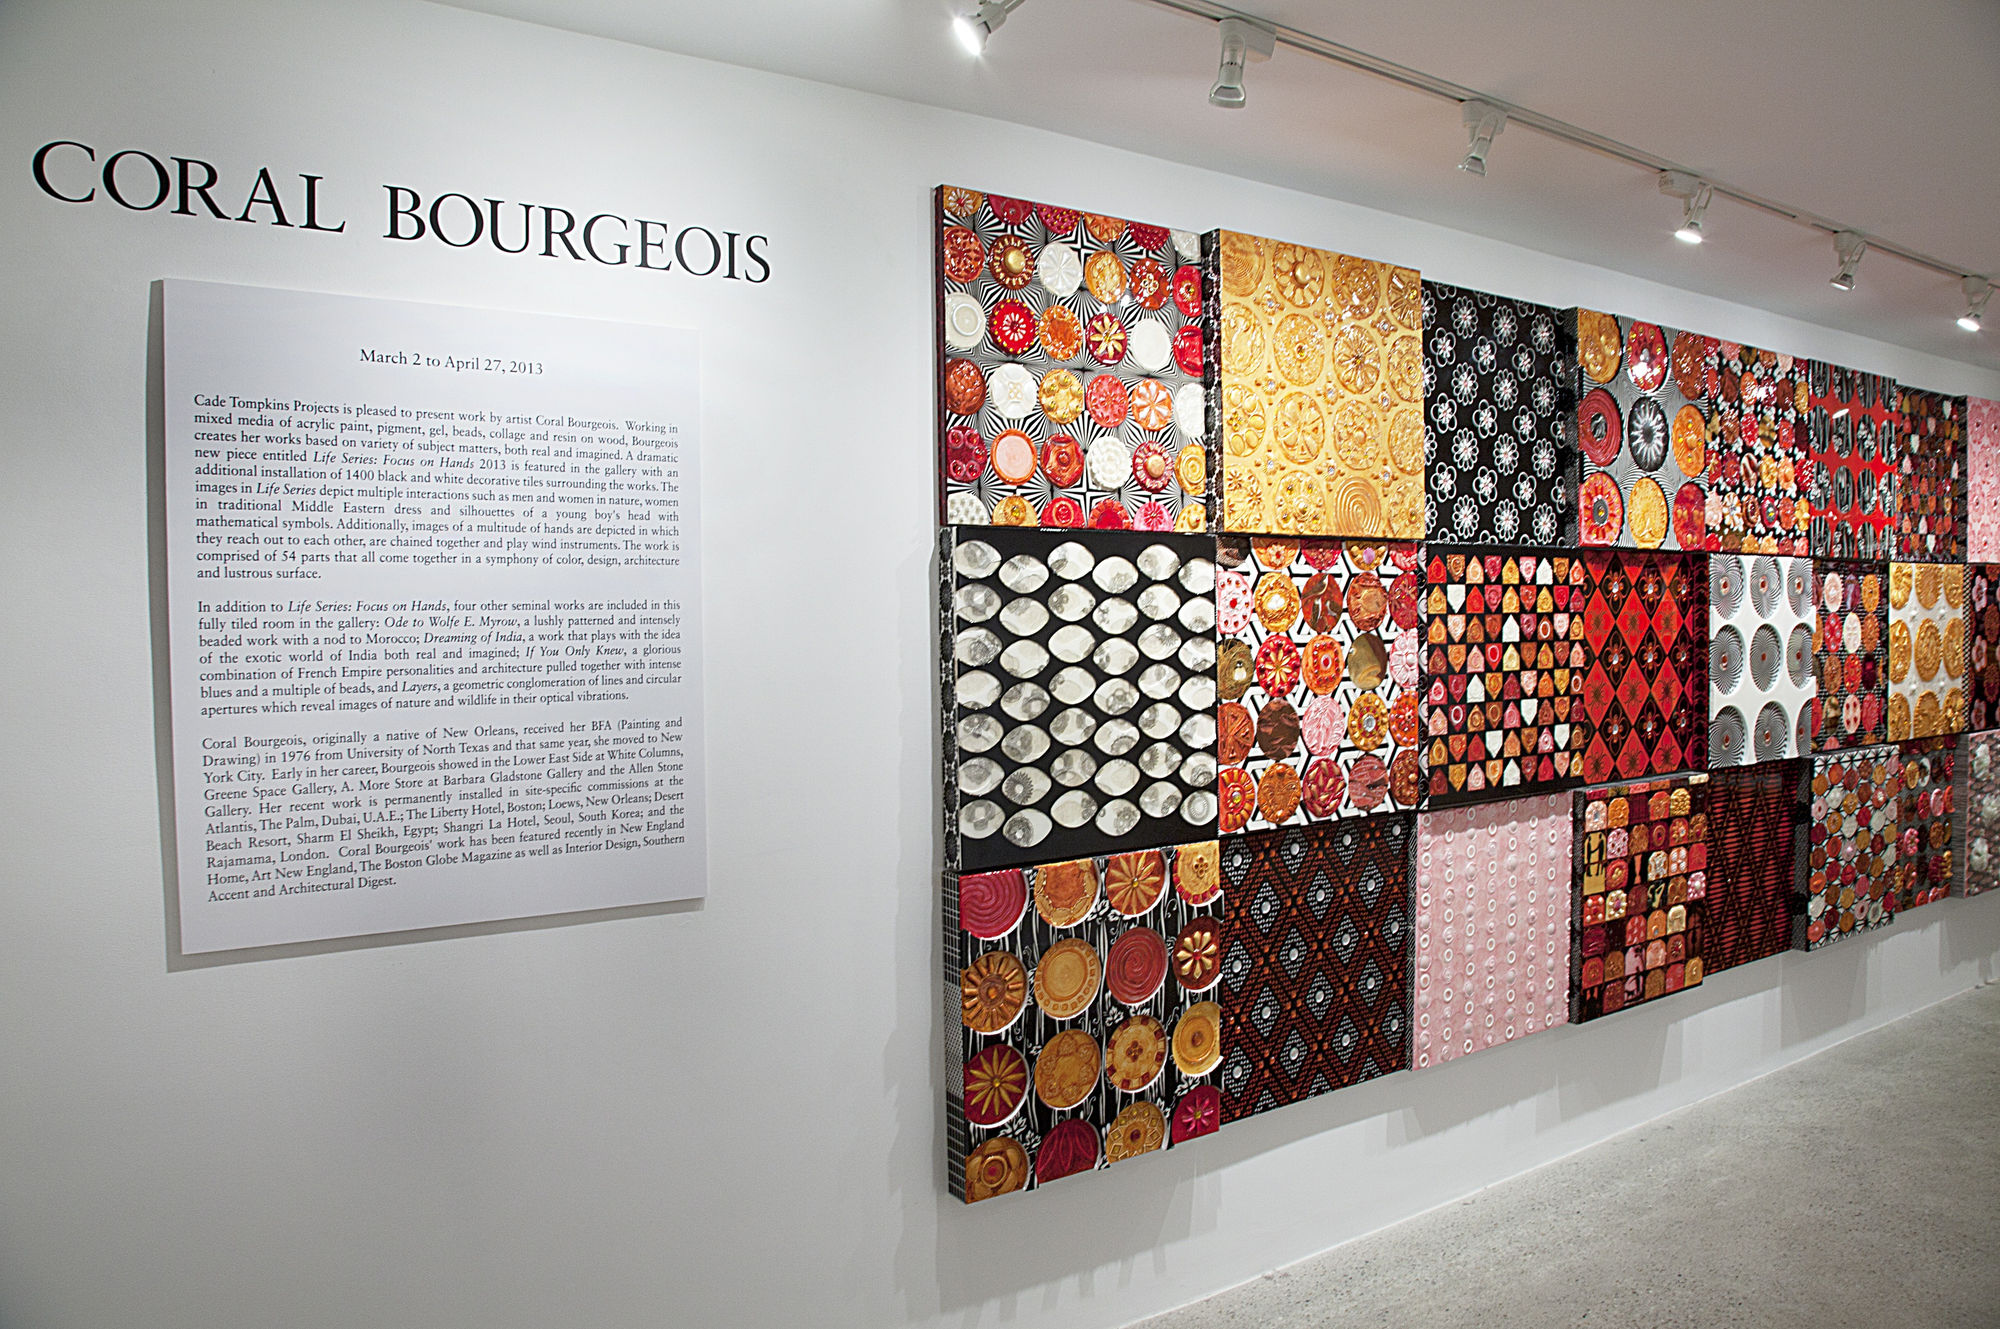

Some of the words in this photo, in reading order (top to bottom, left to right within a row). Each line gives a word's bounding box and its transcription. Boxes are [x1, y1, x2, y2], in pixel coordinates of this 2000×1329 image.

[32, 140, 346, 233] CORAL
[382, 184, 770, 283] BOURGEOIS
[359, 349, 407, 364] March
[412, 353, 421, 366] 2
[426, 357, 440, 367] to
[444, 355, 479, 372] April
[484, 358, 506, 374] 27,
[509, 360, 543, 375] 2013
[193, 393, 226, 407] Cade
[229, 395, 290, 412] Tompkins
[293, 400, 339, 415] Projects
[343, 403, 352, 414] is
[356, 403, 396, 418] pleased
[400, 409, 412, 418] to
[415, 410, 454, 421] present
[458, 410, 485, 422] work
[489, 411, 502, 426] by
[505, 414, 532, 425] artist
[535, 414, 564, 427] Coral
[567, 416, 619, 431] Bourgeois.
[625, 420, 666, 435] Working
[669, 423, 678, 433] in
[194, 411, 232, 425] mixed
[237, 414, 274, 427] media
[279, 415, 292, 427] of
[296, 417, 335, 432] acrylic
[340, 420, 373, 434] paint,
[377, 421, 425, 436] pigment,
[429, 424, 448, 438] gel,
[452, 424, 486, 439] beads,
[489, 427, 526, 442] collage
[529, 430, 549, 441] and
[553, 432, 576, 443] resin
[598, 434, 628, 447] wood,
[632, 435, 679, 450] Bourgeois
[194, 462, 257, 477] additional
[260, 465, 327, 479] installation
[330, 467, 343, 480] of
[346, 469, 374, 481] 1400
[377, 469, 407, 482] black
[410, 471, 431, 483] and
[434, 472, 464, 484] white
[466, 473, 520, 486] decorative
[522, 475, 544, 487] tiles
[546, 477, 607, 492] surrounding
[609, 479, 624, 490] the
[626, 480, 659, 491] works.
[660, 481, 679, 492] The
[195, 497, 208, 509] in
[217, 498, 281, 511] traditional
[291, 500, 334, 512] Middle
[343, 501, 385, 514] Eastern
[393, 502, 422, 515] dress
[430, 504, 451, 516] and
[459, 504, 515, 517] silhouettes
[522, 506, 534, 518] of
[541, 510, 547, 518] a
[556, 511, 587, 522] young
[594, 508, 620, 522] boy's
[627, 509, 650, 521] head
[658, 510, 679, 521] with
[196, 549, 259, 564] comprised
[264, 549, 278, 561] of
[281, 550, 296, 562] 54
[301, 553, 330, 565] parts
[334, 550, 357, 562] that
[361, 550, 375, 563] all
[379, 554, 409, 563] come
[412, 551, 458, 566] together
[461, 552, 471, 563] in
[475, 556, 481, 564] a
[485, 552, 539, 567] symphony
[542, 552, 553, 564] of
[556, 553, 584, 566] color,
[587, 553, 621, 568] design,
[623, 554, 680, 566] architecture
[197, 565, 220, 578] and
[224, 566, 273, 578] lustrous
[276, 566, 321, 579] surface.
[198, 617, 226, 632] fully
[231, 617, 258, 629] tiled
[262, 620, 295, 629] room
[299, 617, 311, 629] in
[315, 616, 334, 629] the
[337, 616, 379, 631] gallery:
[384, 615, 409, 628] Ode
[412, 618, 424, 627] to
[428, 615, 460, 629] Wolfe
[463, 616, 475, 627] E.
[478, 615, 520, 629] Myrow,
[523, 618, 530, 626] a
[534, 614, 564, 629] lushly
[567, 614, 614, 628] patterned
[617, 614, 636, 625] and
[639, 613, 680, 627] intensely
[199, 668, 276, 681] combination
[280, 666, 294, 679] of
[297, 666, 337, 679] French
[341, 665, 382, 680] Empire
[386, 663, 454, 679] personalities
[457, 662, 478, 674] and
[481, 662, 543, 674] architecture
[546, 660, 577, 675] pulled
[580, 659, 621, 674] together
[624, 658, 645, 670] with
[648, 659, 682, 669] intense
[201, 736, 237, 750] Coral
[244, 734, 307, 749] Bourgeois,
[312, 730, 367, 747] originally
[373, 733, 380, 742] a
[386, 729, 420, 741] native
[425, 727, 437, 739] of
[442, 727, 468, 738] New
[474, 724, 518, 737] Orleans,
[523, 721, 564, 734] received
[569, 721, 586, 732] her
[591, 720, 612, 731] BFA
[617, 718, 660, 731] (Painting
[664, 716, 682, 728] and
[204, 804, 252, 818] Gallery.
[259, 802, 282, 814] Her
[289, 801, 325, 812] recent
[331, 795, 362, 809] work
[368, 795, 378, 807] is
[384, 790, 452, 809] permanently
[458, 786, 503, 800] installed
[509, 786, 519, 797] in
[525, 781, 582, 797] site-specific
[587, 779, 649, 792] commissions
[654, 779, 663, 787] at
[669, 775, 684, 786] the
[206, 837, 242, 852] Beach
[248, 836, 291, 848] Resort,
[296, 832, 334, 845] Sharm
[339, 828, 352, 841] El
[357, 826, 398, 840] Sheikh,
[403, 825, 438, 839] Egypt;
[443, 819, 484, 834] Shangri
[489, 818, 502, 830] La
[507, 814, 540, 828] Hotel,
[543, 812, 574, 825] Seoul,
[578, 809, 607, 822] South
[611, 808, 644, 820] Korea;
[647, 805, 665, 817] and
[669, 804, 684, 815] the
[207, 890, 250, 902] Accent
[253, 884, 276, 898] and
[278, 876, 354, 896] Architectural
[358, 876, 397, 890] Digest.
